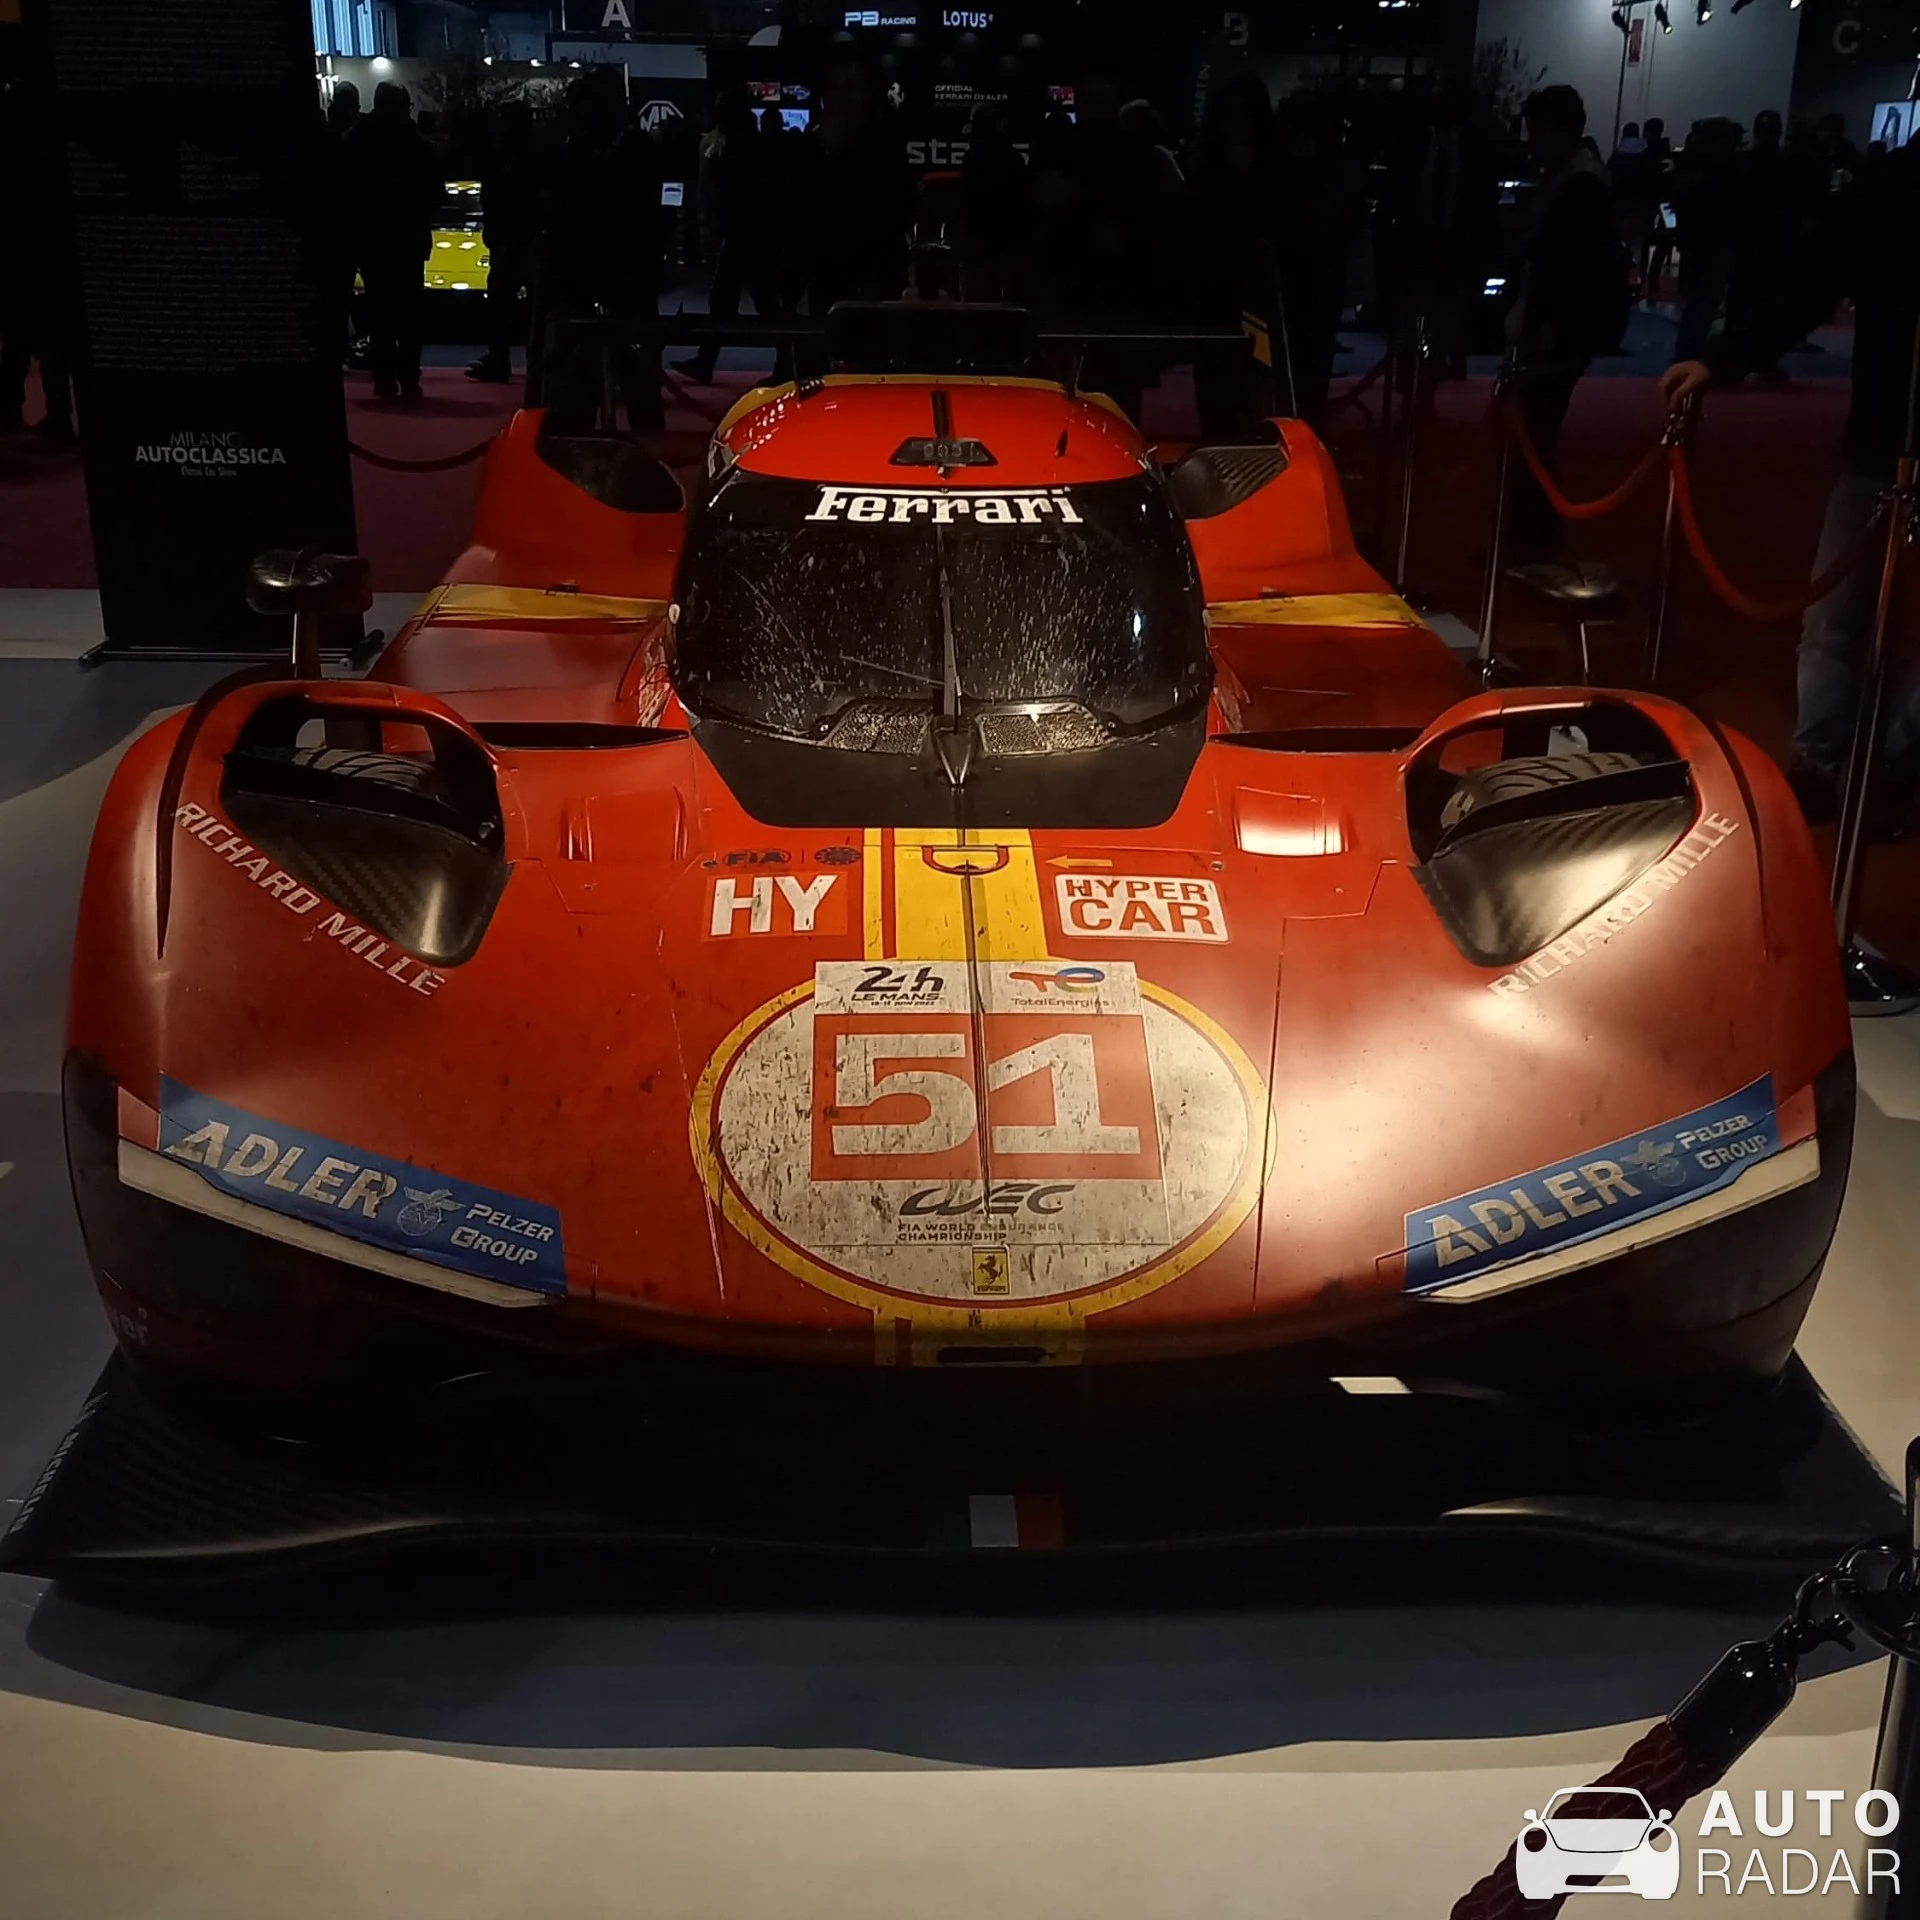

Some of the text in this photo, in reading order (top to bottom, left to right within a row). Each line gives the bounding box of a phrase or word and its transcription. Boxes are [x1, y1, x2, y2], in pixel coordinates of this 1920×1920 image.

[601, 0, 631, 27] A
[881, 16, 917, 26] RACING
[943, 10, 987, 28] LOTUS
[1832, 20, 1861, 54] C
[934, 84, 974, 92] OFFICIAL
[934, 93, 972, 101] FERRARI
[135, 445, 287, 465] AUTOCLASSICA
[169, 431, 243, 448] MILANO
[805, 486, 1084, 524] Ferrari
[171, 801, 446, 996] RICHARD MILLE
[711, 875, 838, 936] HY
[1065, 879, 1207, 901] HYPER
[1488, 812, 1740, 998] RICHARD MILLE
[1070, 900, 1215, 936] CAR
[852, 993, 940, 1001] LE MANS
[831, 1032, 1140, 1155] 51
[1698, 1132, 1769, 1170] GROUP
[163, 1119, 555, 1242] ADLER PELZER
[1427, 1112, 1752, 1269] ADLER PELZER
[900, 1183, 1076, 1216] WEC
[899, 1223, 921, 1232] FIA
[926, 1223, 976, 1232] WORLD
[899, 1232, 1008, 1241] CHAMPIONSHIP
[450, 1226, 538, 1265] GROUP
